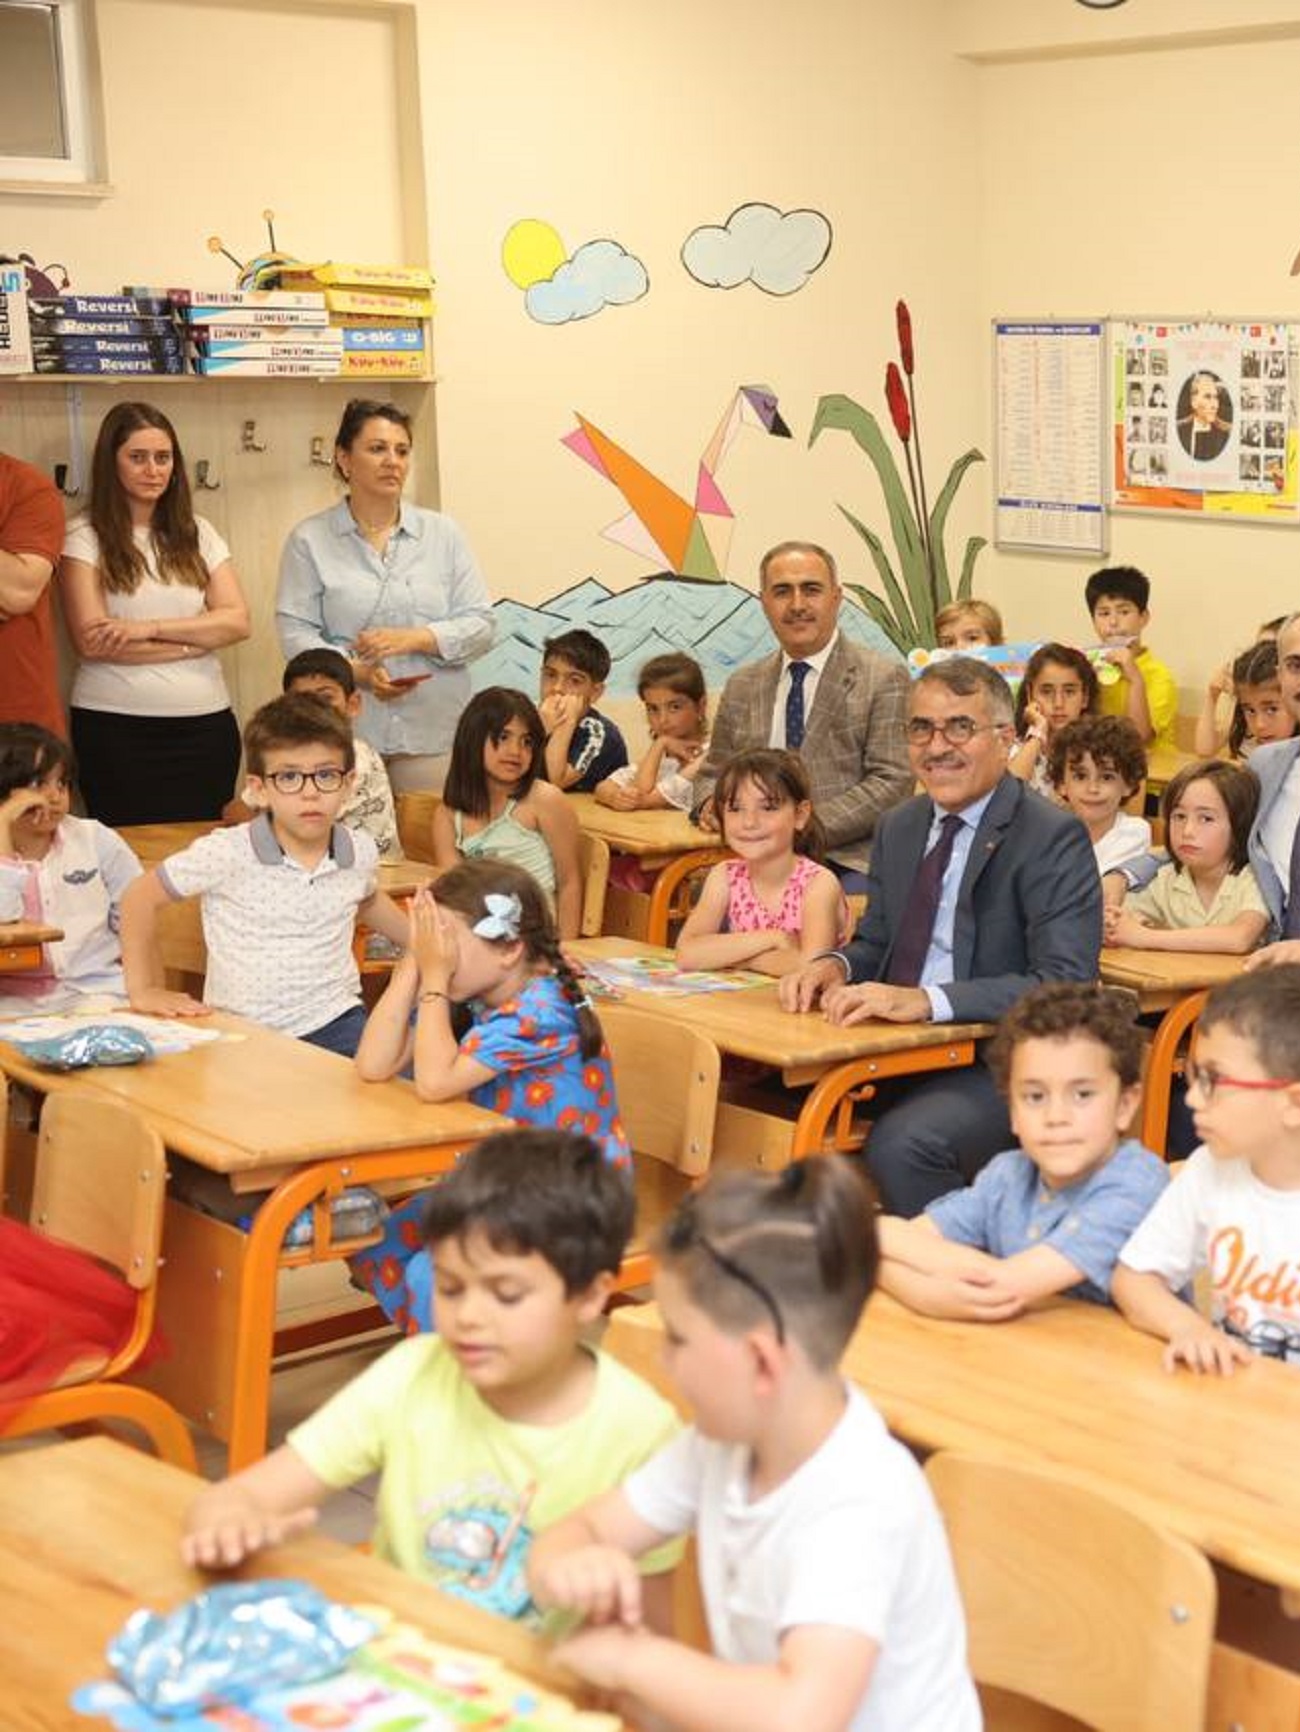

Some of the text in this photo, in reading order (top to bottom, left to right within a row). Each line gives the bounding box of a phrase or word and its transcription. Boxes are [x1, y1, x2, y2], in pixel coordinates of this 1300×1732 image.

[76, 299, 138, 313] Reversi
[63, 319, 130, 333] Reversi
[95, 340, 149, 353] Reversi
[99, 358, 153, 371] Reversi
